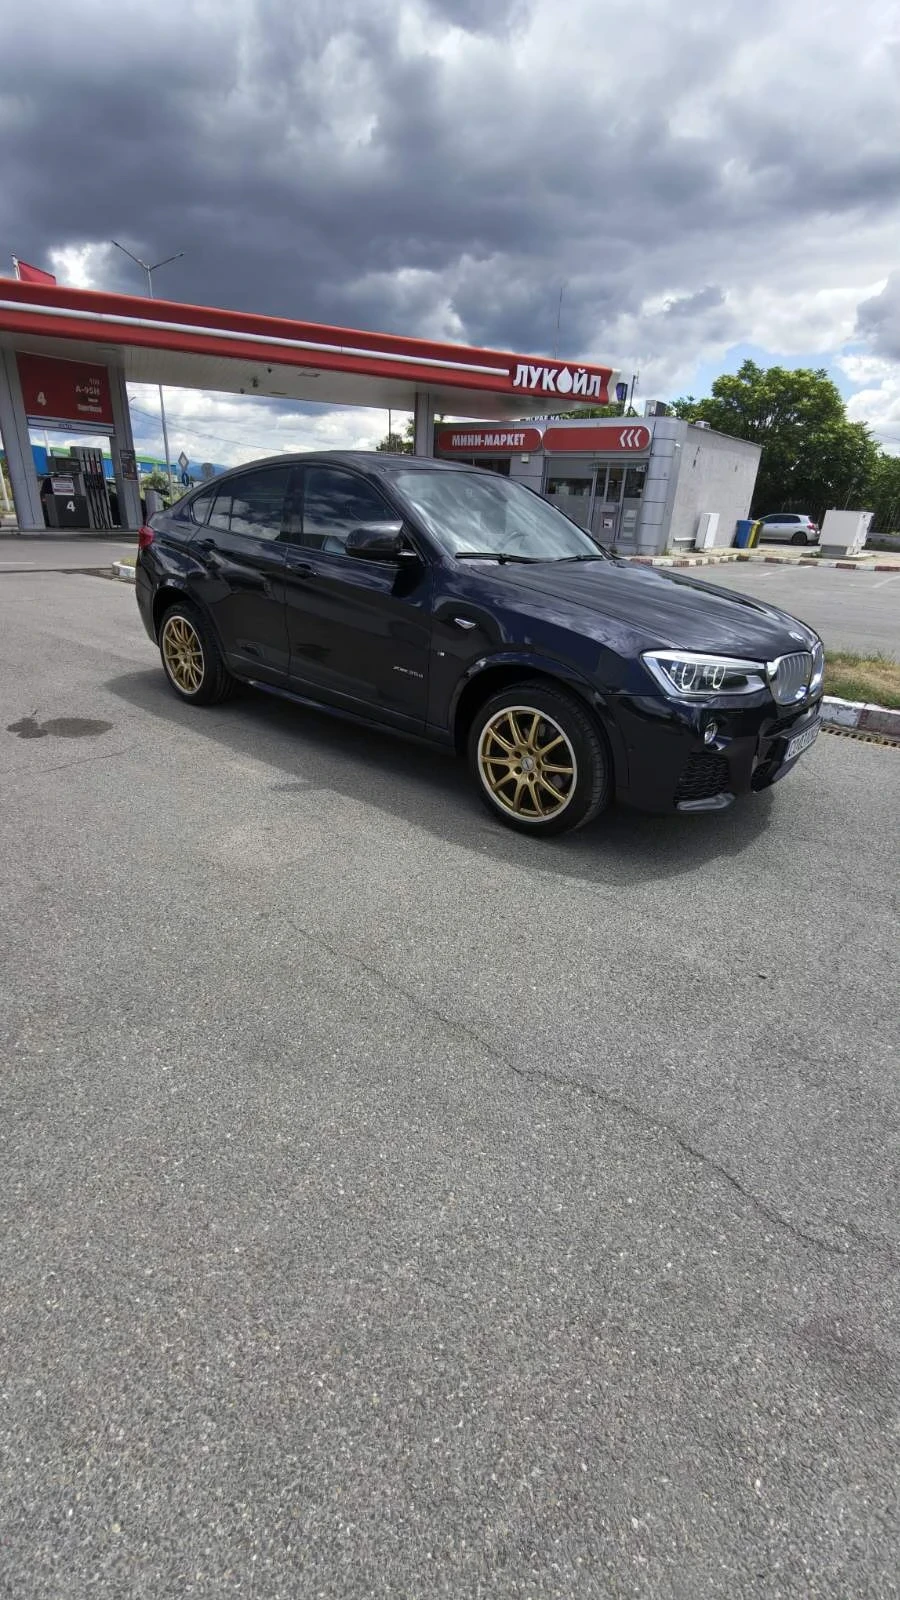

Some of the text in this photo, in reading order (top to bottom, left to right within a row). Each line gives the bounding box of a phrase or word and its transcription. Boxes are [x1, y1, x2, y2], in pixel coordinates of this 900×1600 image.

[513, 364, 601, 397] ЛУКОЙЛ
[37, 391, 47, 406] 4
[452, 433, 526, 446] МИНИ-МАРКЕТ
[66, 500, 76, 512] 4
